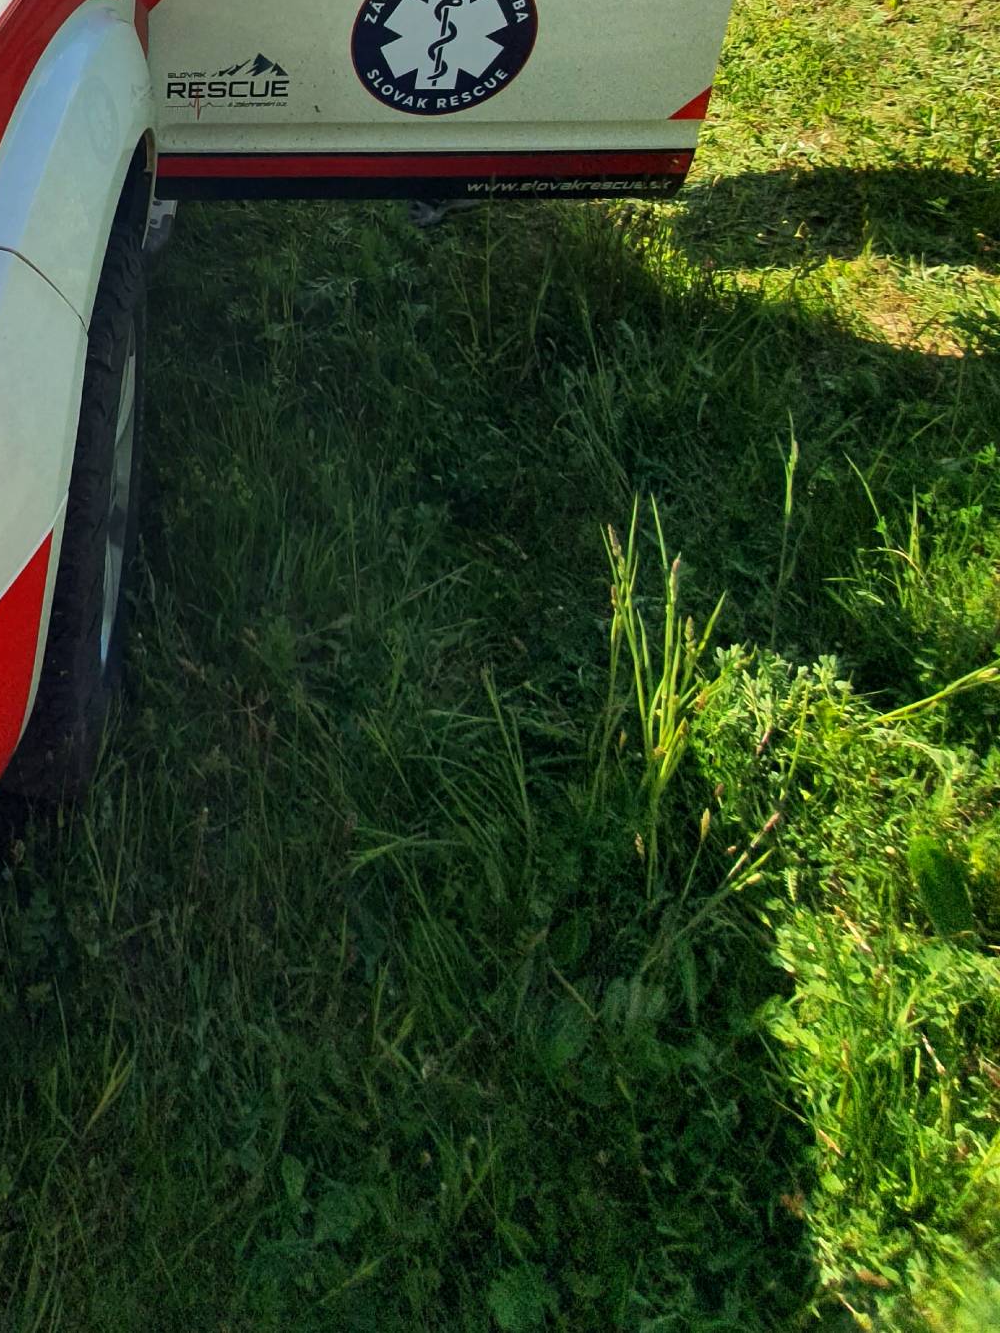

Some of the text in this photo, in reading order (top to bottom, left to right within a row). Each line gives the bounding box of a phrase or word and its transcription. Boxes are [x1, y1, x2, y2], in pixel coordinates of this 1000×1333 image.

[167, 80, 290, 99] RESCUE
[366, 68, 509, 109] SLOVAK RESCUE
